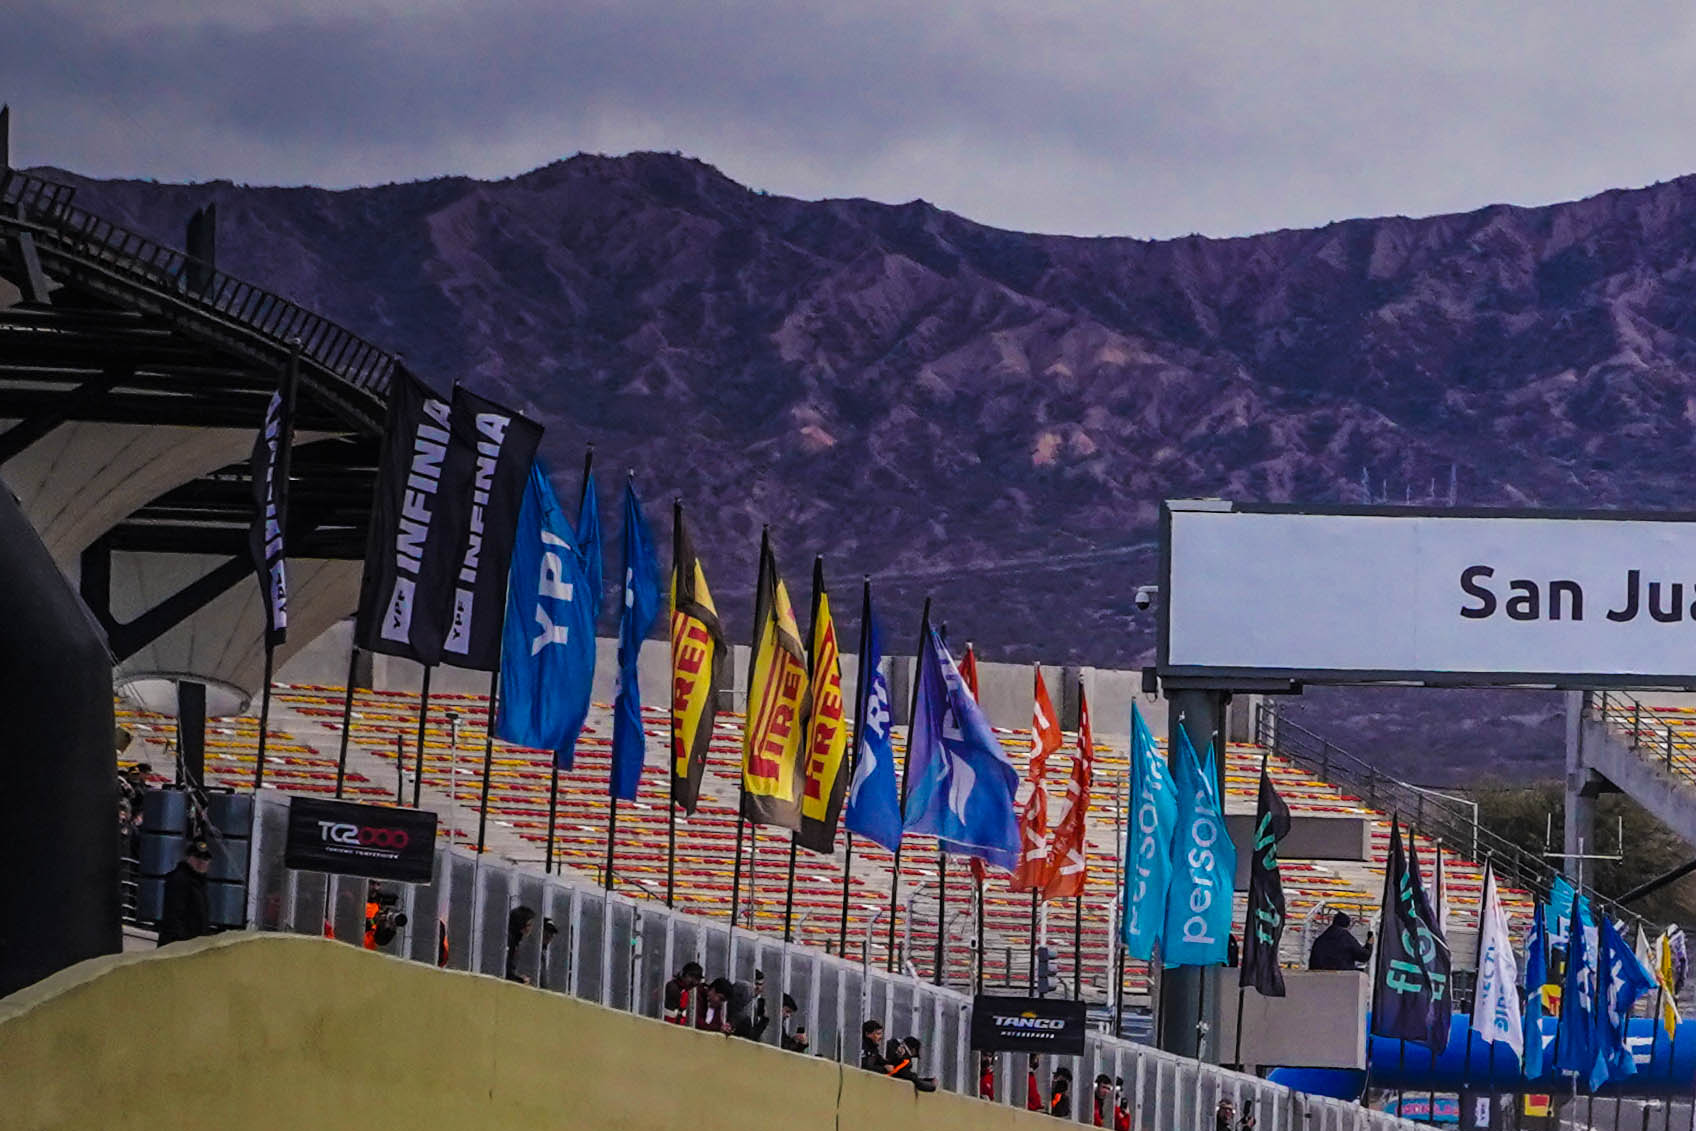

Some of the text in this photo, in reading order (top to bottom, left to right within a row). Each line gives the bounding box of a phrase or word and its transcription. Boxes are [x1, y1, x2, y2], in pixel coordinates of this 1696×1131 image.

[396, 399, 452, 576] INFINIA
[453, 413, 511, 640] YPF INFINIA
[1460, 565, 1584, 624] San
[318, 821, 409, 849] TC2000
